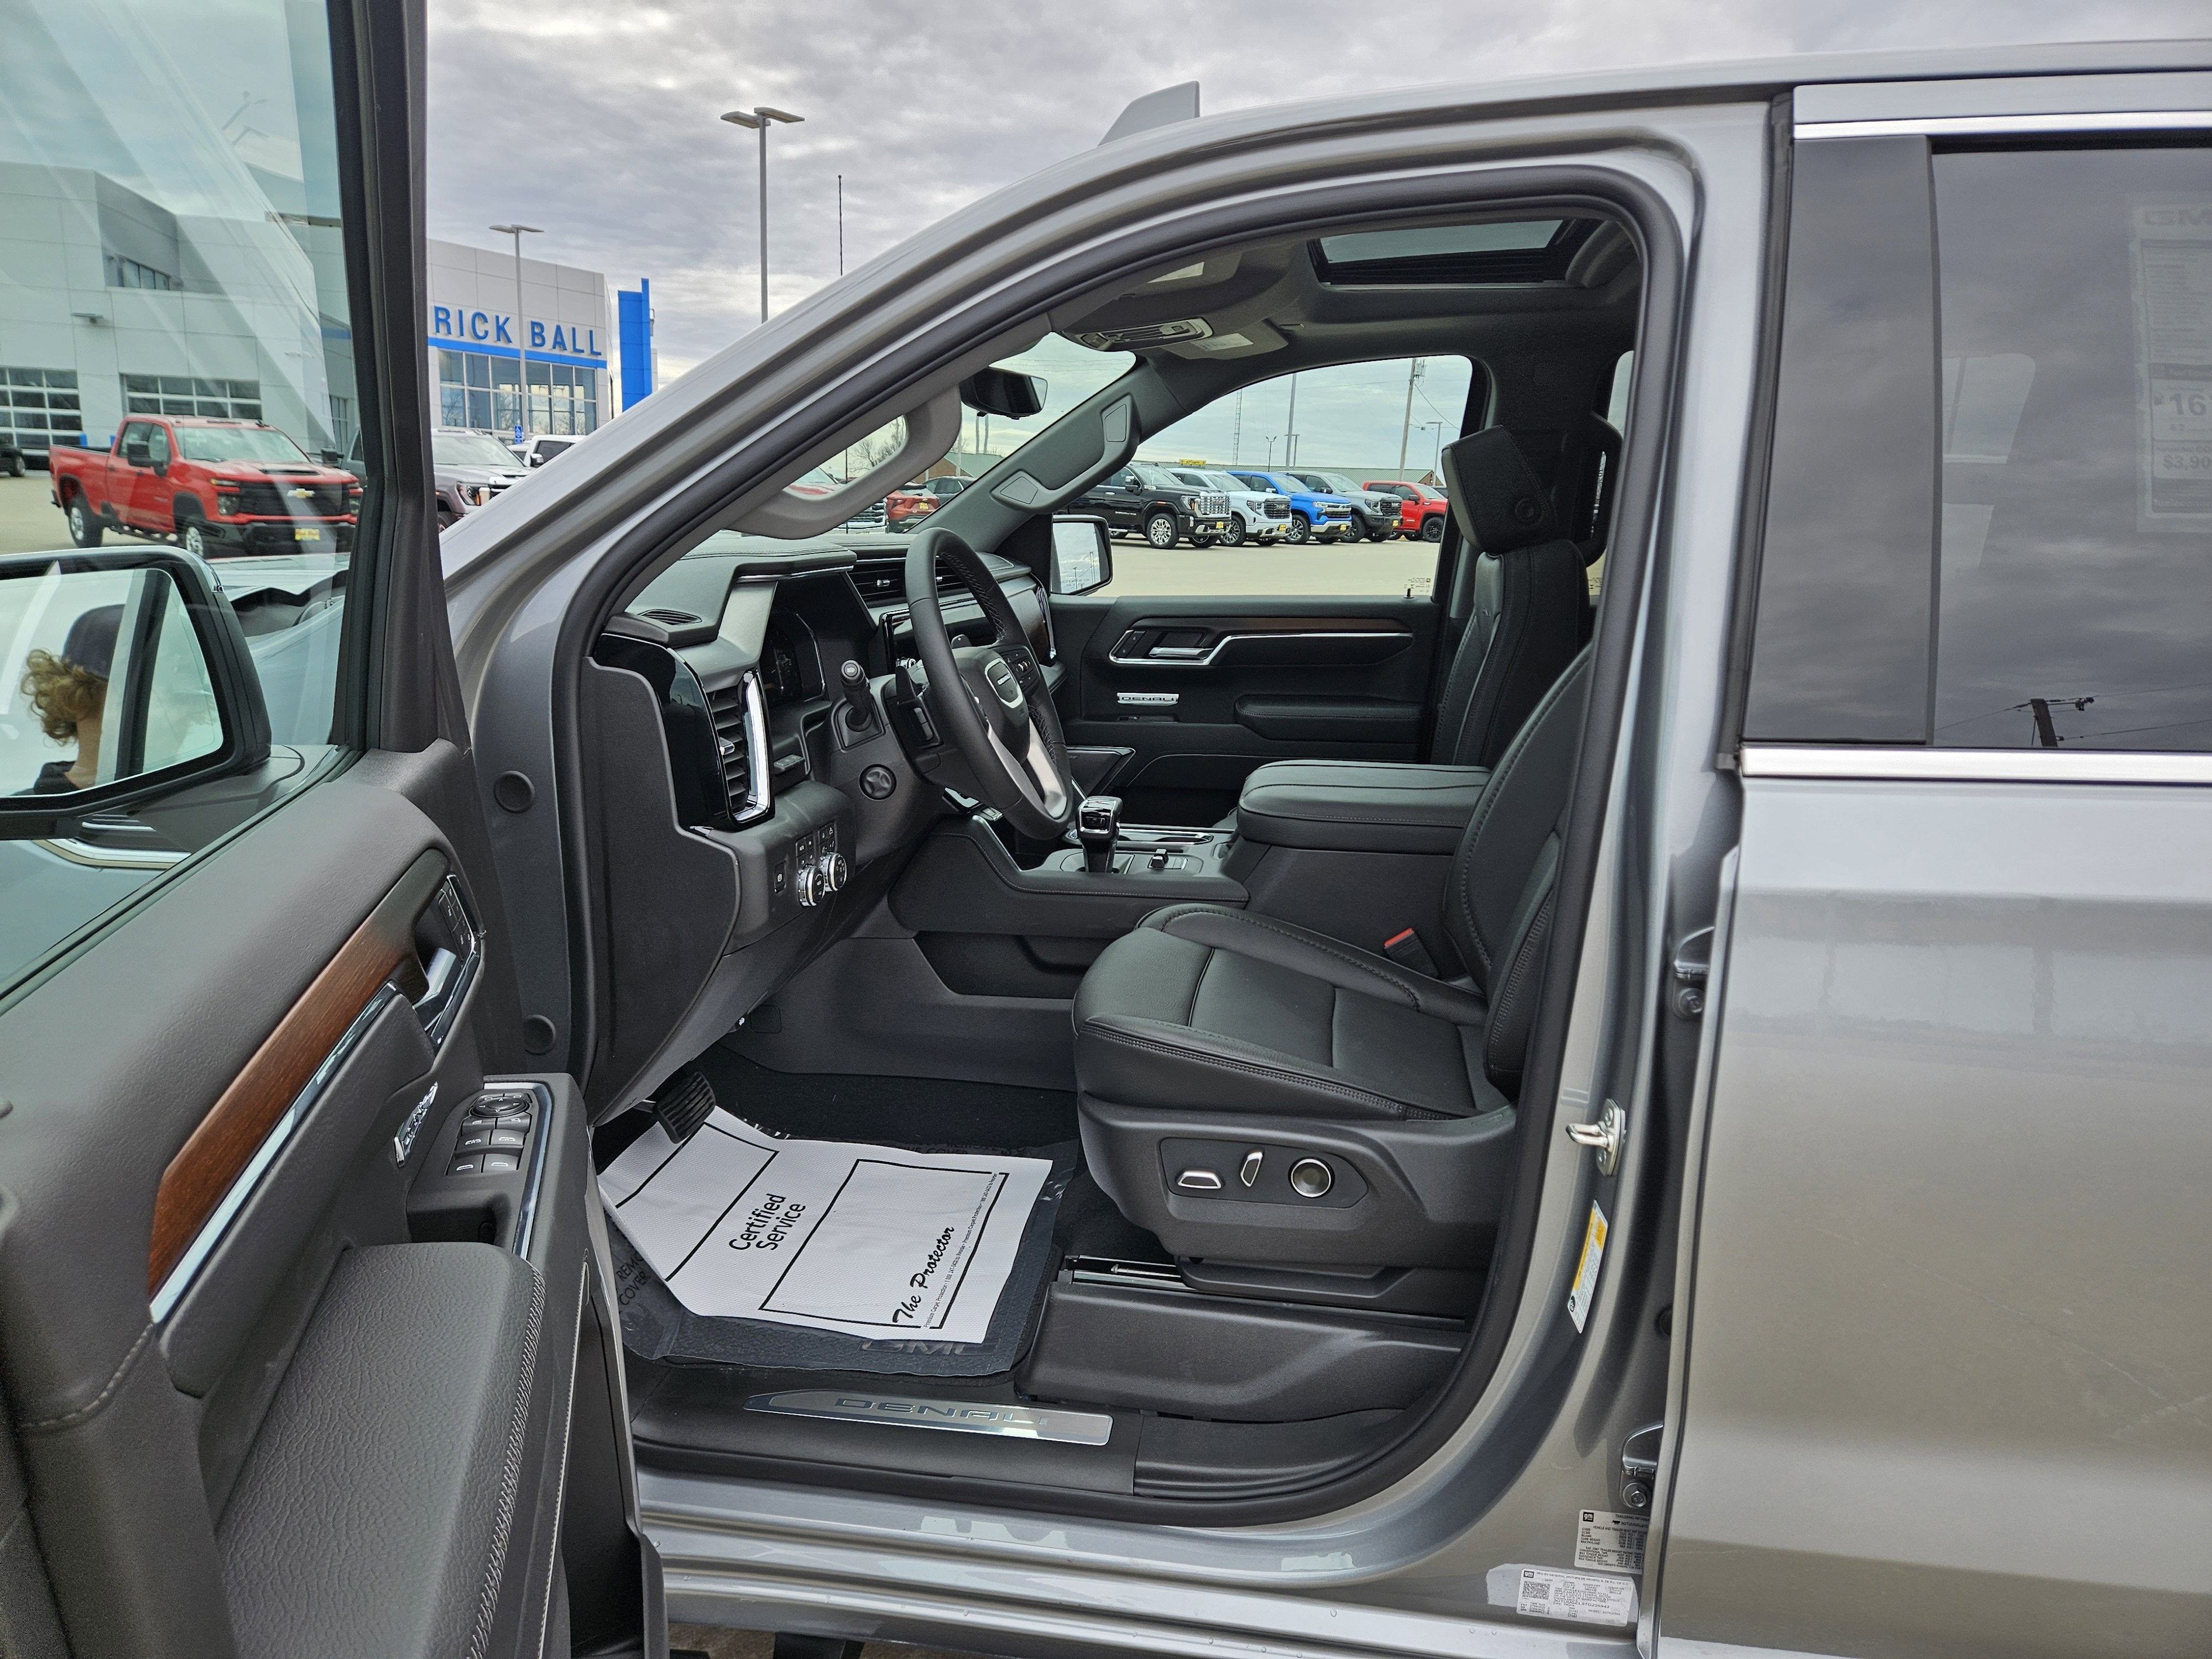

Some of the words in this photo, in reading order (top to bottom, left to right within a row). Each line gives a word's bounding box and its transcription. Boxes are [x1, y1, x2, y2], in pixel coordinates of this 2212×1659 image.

[434, 305, 512, 343] RICK
[530, 320, 602, 356] BALL
[2169, 393, 2206, 416] 16
[2163, 455, 2212, 471] $3,90
[729, 1193, 786, 1250] Certified
[755, 1204, 806, 1250] Service
[619, 1271, 651, 1305] COVER
[892, 1295, 921, 1323] The
[910, 1227, 954, 1288] Protector
[835, 1398, 1050, 1425] DENALI
